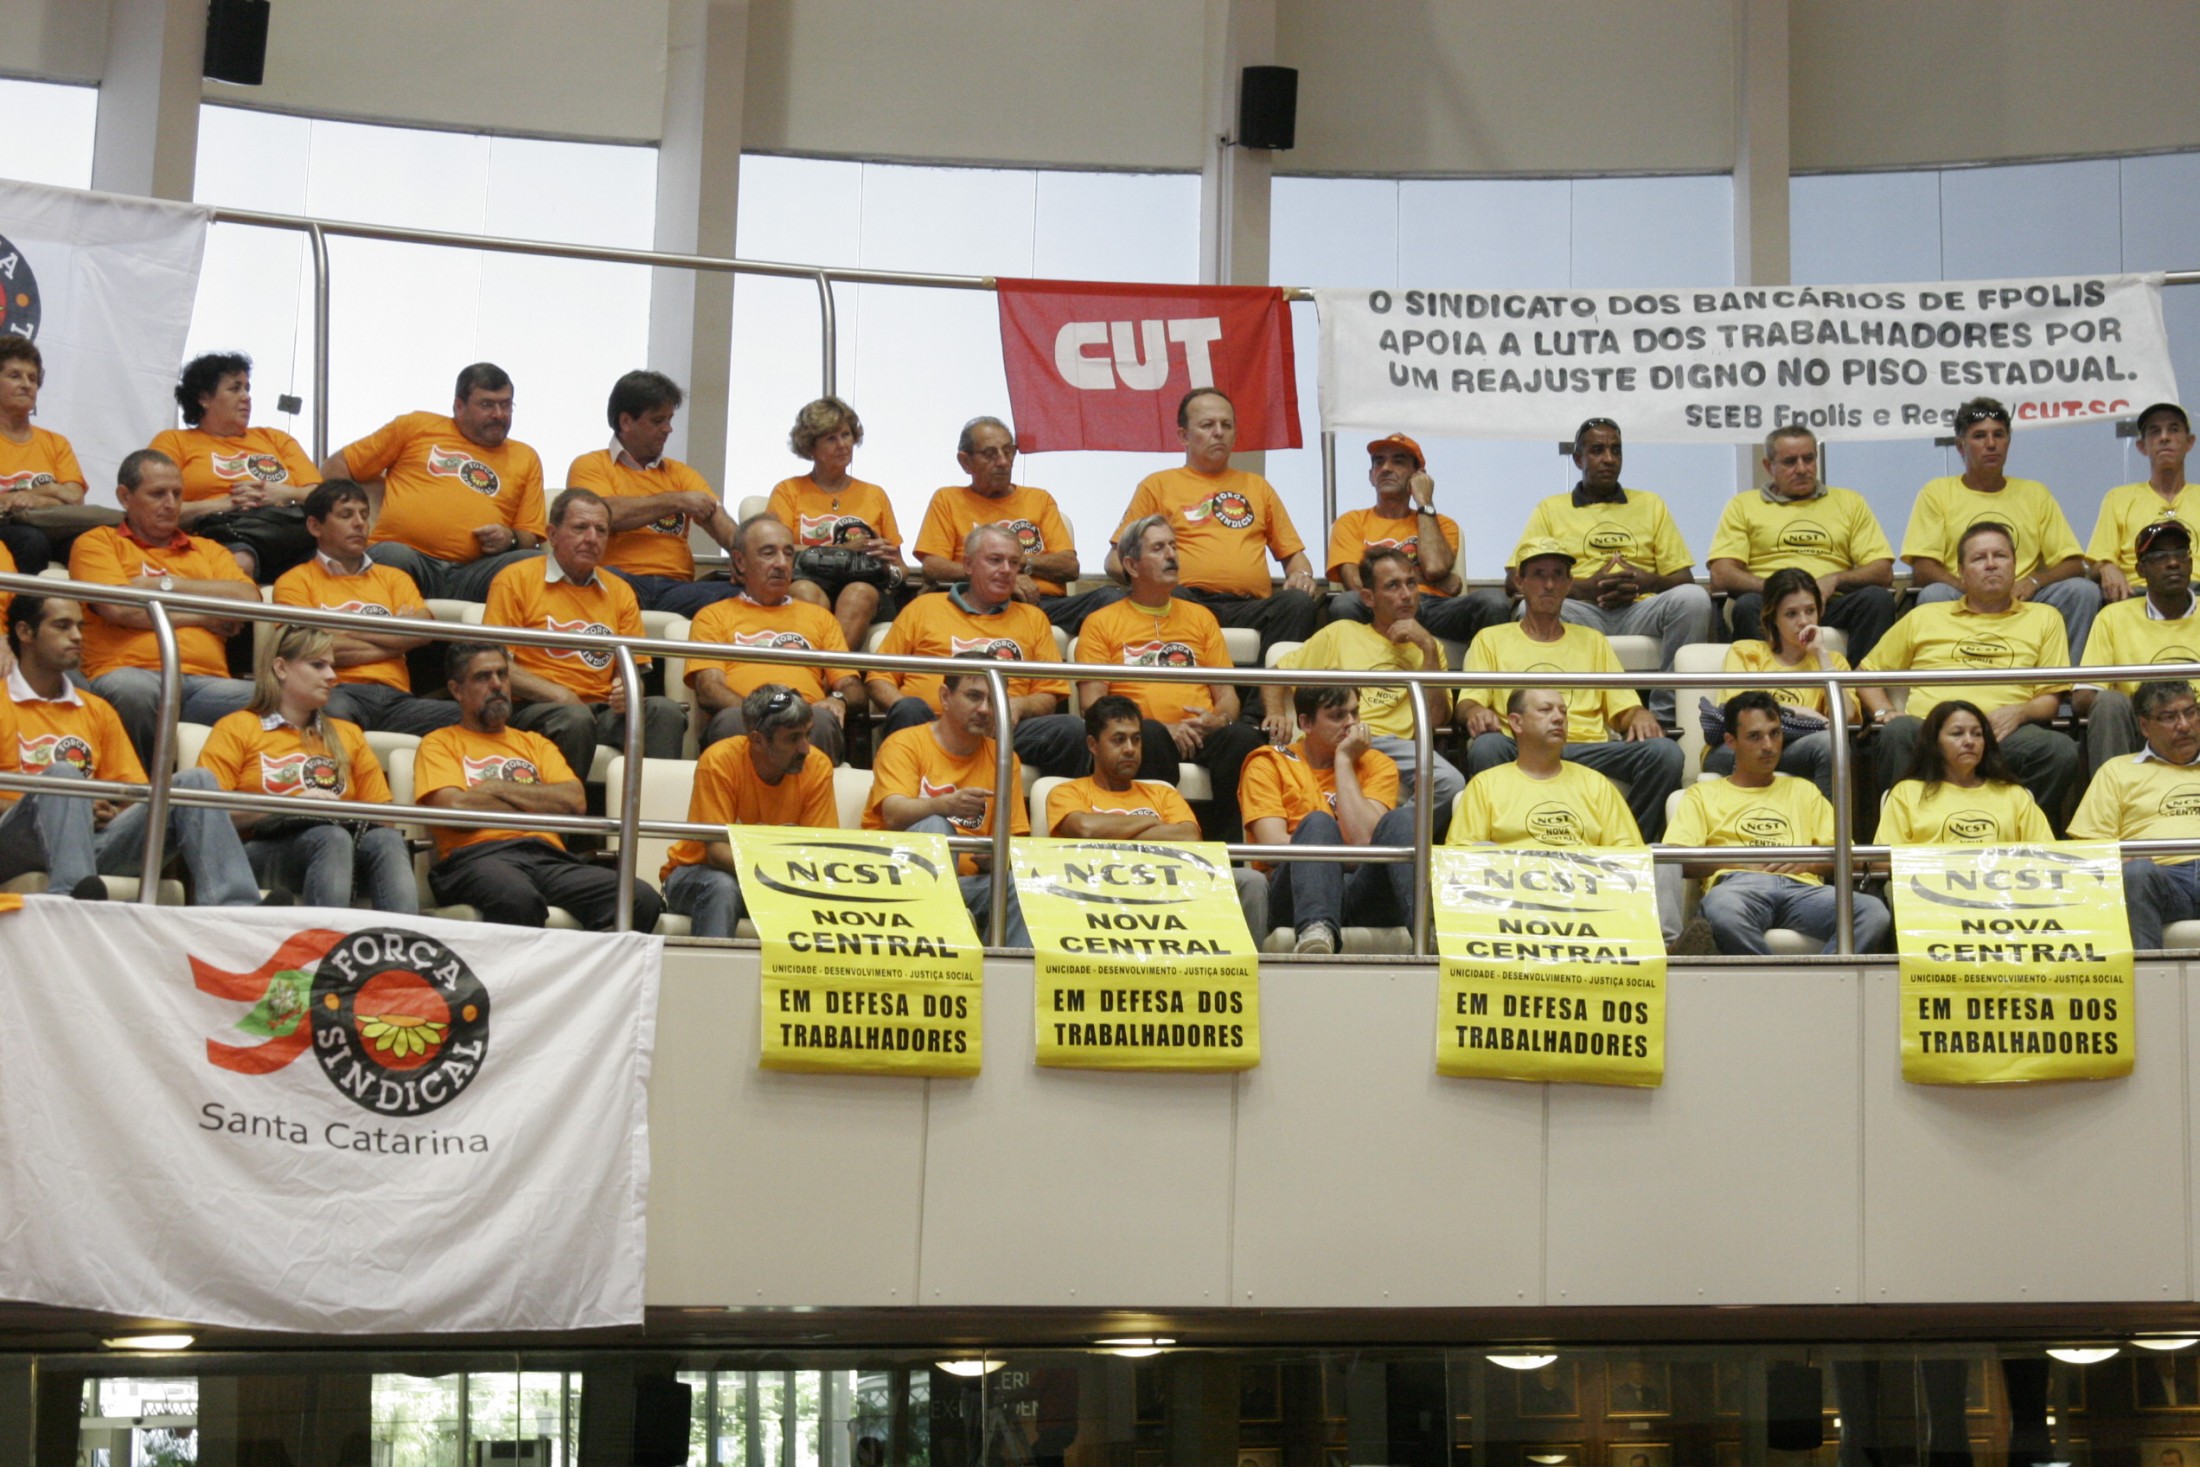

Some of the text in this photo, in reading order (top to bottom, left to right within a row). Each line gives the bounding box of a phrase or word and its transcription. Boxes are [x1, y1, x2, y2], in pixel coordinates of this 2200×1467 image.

[1368, 279, 2107, 320] O SINDICATO DOS BANCÁRIOS DE FPOLIS
[1378, 316, 2122, 357] APOIA A LUTA DOS TRABALHADORES POR
[1054, 316, 1223, 391] CUT
[1388, 354, 2139, 394] UM REAJUSTE DIGNO NO PISO ESTADUAL.
[1684, 403, 1763, 429] SEEB
[1773, 402, 1863, 428] Fpolis
[1872, 407, 1891, 427] e
[1901, 402, 1957, 428] Reg
[1537, 814, 1570, 824] NCST
[1546, 827, 1571, 836] NOVA
[1746, 822, 1779, 831] NCST
[1956, 823, 1988, 832] NCST
[786, 861, 905, 886] NCST
[1063, 862, 1183, 886] NCST
[1483, 868, 1604, 896] NCST
[1945, 868, 2070, 891] NCST
[811, 909, 914, 928] NOVA
[1086, 912, 1188, 931] NOVA
[1498, 918, 1599, 938] NOVA
[1960, 918, 2066, 935] NOVA
[787, 931, 959, 959] CENTRAL
[1059, 936, 1232, 956] CENTRAL
[1466, 941, 1641, 967] CENTRAL
[1927, 942, 2107, 963] CENTRAL
[331, 933, 465, 992] FORÇA
[772, 964, 974, 982] UNICIDADE DESENVOLVIMENTO JUSTIÇA SOCIAL
[1045, 964, 1249, 978] UNICIDADE DESENVOLVIMENTO JUSTIÇA SOCIAL
[1449, 968, 1656, 989] UNICIDADE DESENVOLVIMENTO JUSTIÇA SOCIAL
[1910, 973, 2124, 986] UNICIDADE DESENVOLVIMENTO JUSTIÇA SOCIAL
[780, 989, 968, 1019] EM DEFESA DOS
[1053, 989, 1243, 1014] EM DEFESA DOS
[1456, 992, 1648, 1025] EM DEFESA DOS
[1919, 997, 2118, 1021] EM DEFESA DOS
[780, 1023, 968, 1054] TRABALHADORES
[1053, 1023, 1244, 1048] TRABALHADORES
[1455, 1025, 1648, 1058] TRABALHADORES
[1919, 1031, 2119, 1056] TRABALHADORES
[317, 1024, 483, 1113] SINDICAL
[199, 1102, 490, 1155] Santa Catarina
